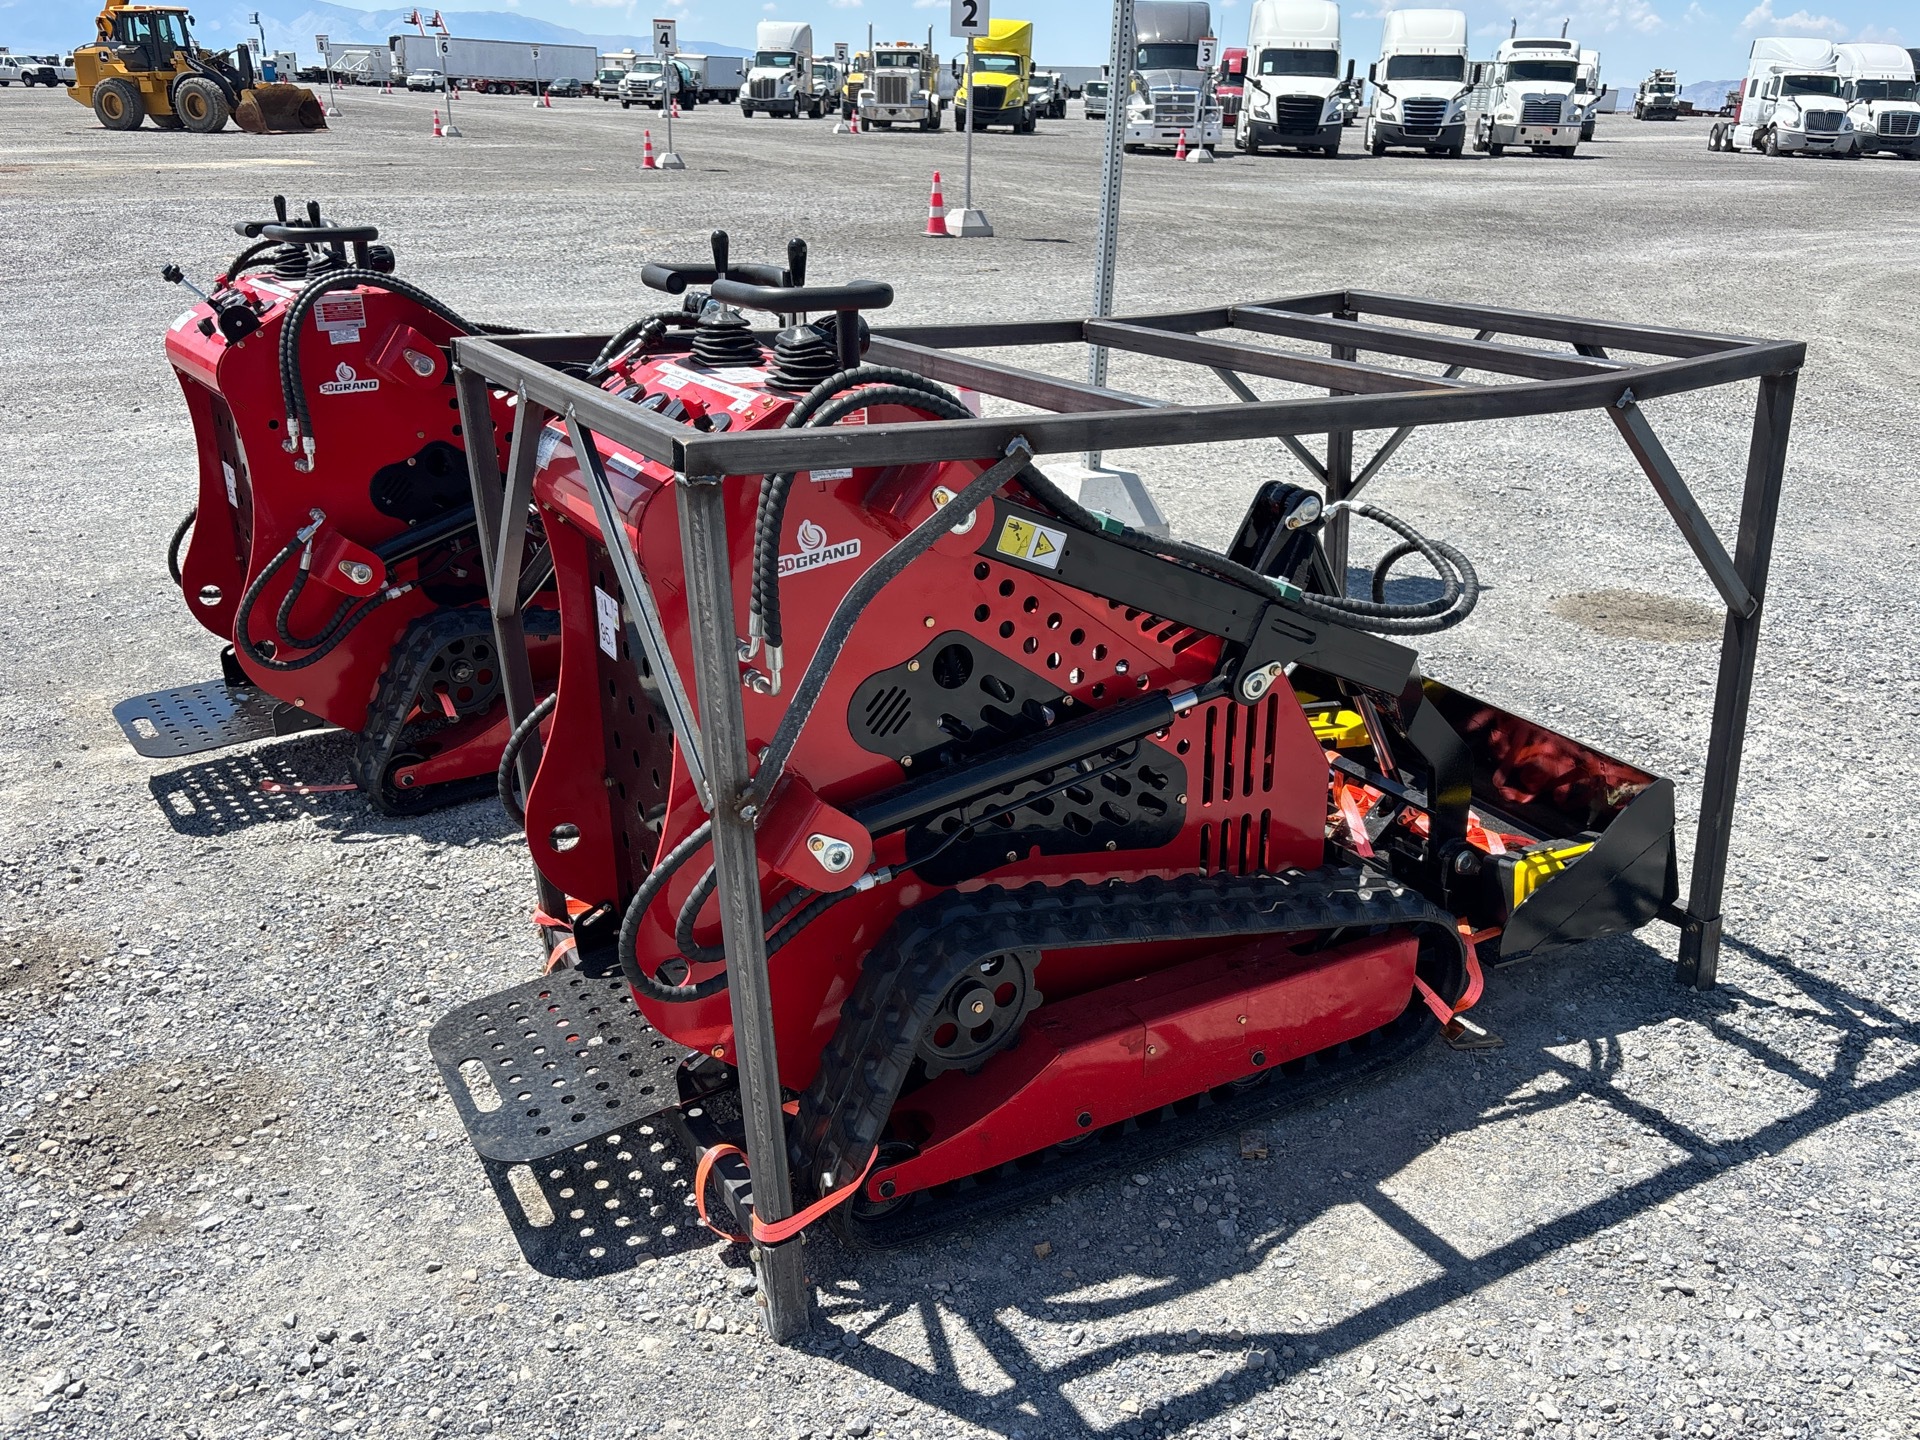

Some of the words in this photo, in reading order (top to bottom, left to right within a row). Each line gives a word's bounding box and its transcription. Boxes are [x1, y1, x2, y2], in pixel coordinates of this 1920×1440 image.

[961, 0, 978, 27] 2
[319, 41, 324, 50] 8
[659, 32, 670, 48] 4
[441, 42, 448, 53] 6
[838, 50, 845, 60] 5
[1202, 48, 1211, 62] 3
[321, 381, 377, 393] SDGRAND
